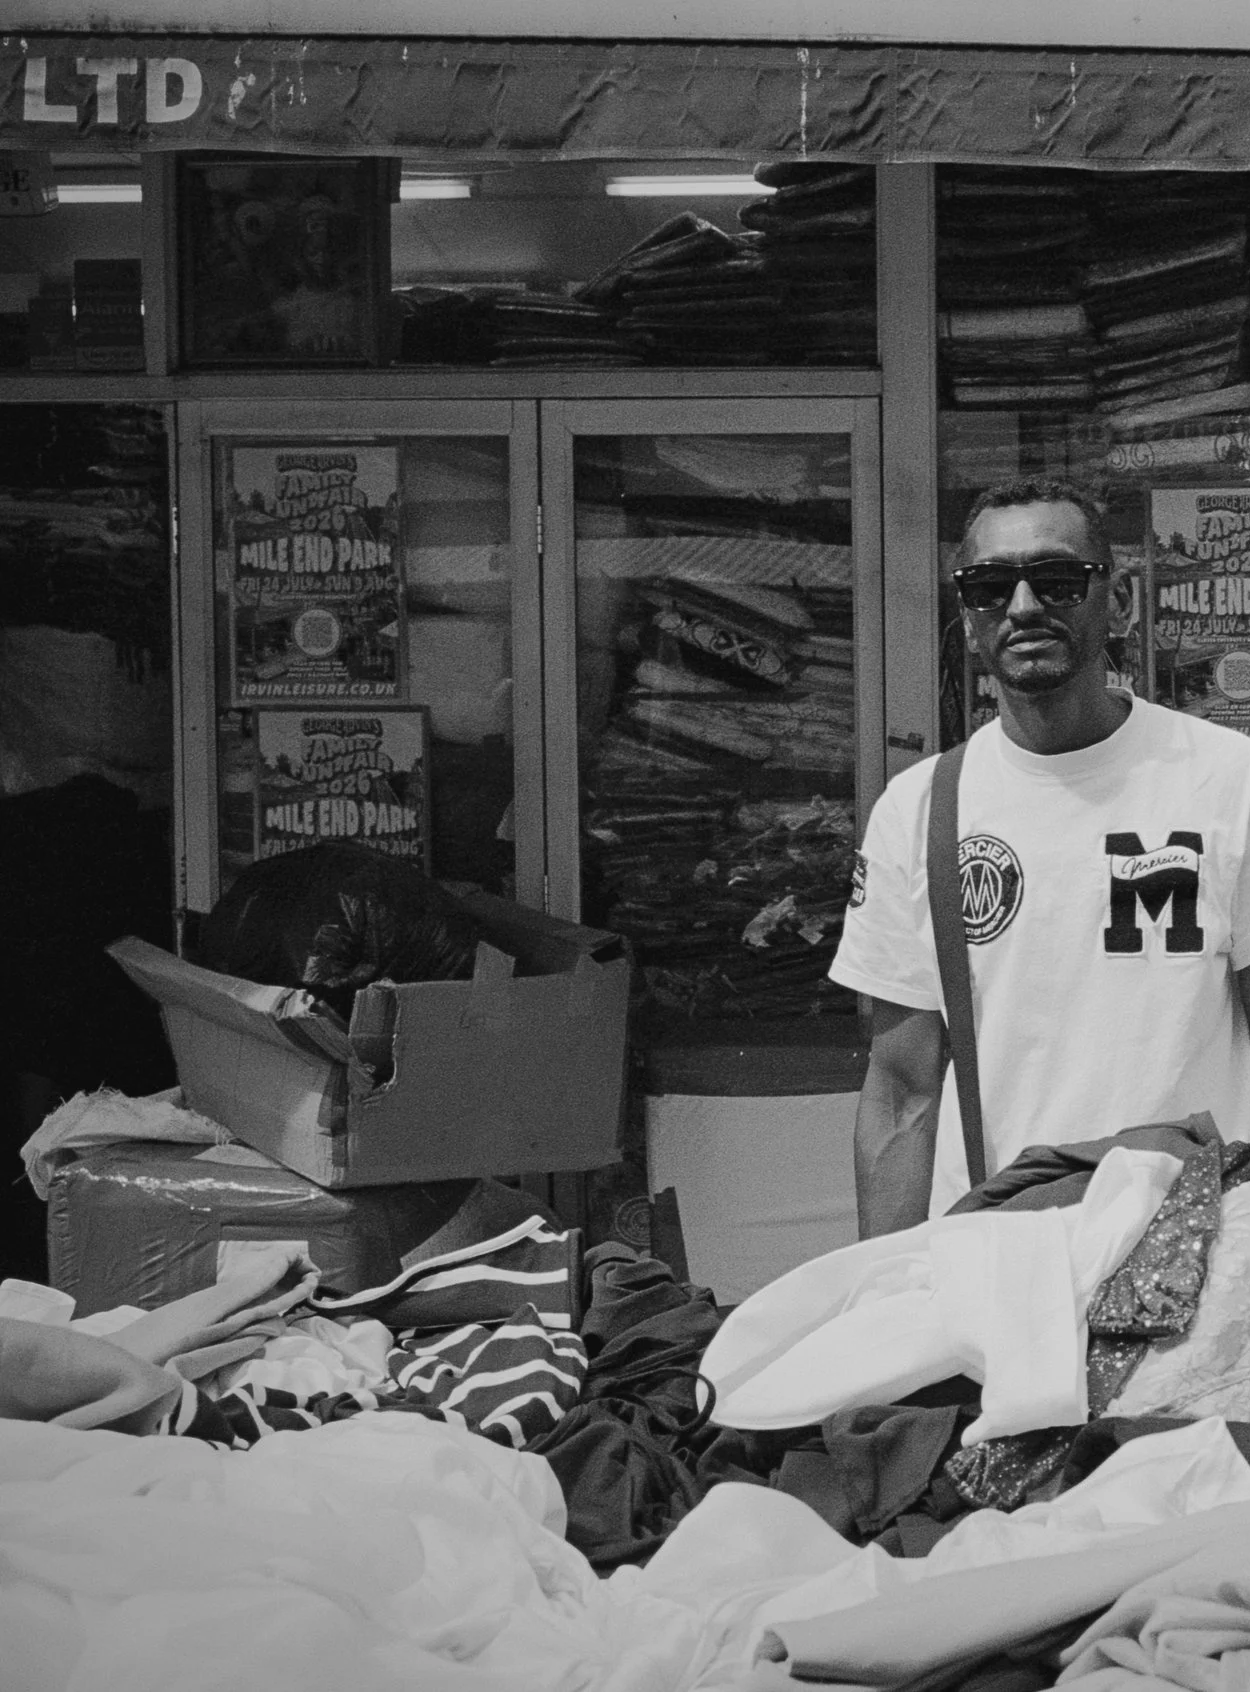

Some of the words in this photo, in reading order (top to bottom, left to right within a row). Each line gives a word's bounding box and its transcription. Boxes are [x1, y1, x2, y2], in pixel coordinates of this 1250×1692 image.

[22, 57, 204, 124] LTD
[276, 473, 357, 499] FAMILY
[1197, 494, 1239, 511] GEORGE
[288, 505, 346, 532] 2026
[240, 537, 289, 572] MILE
[293, 534, 334, 573] END
[338, 537, 392, 572] PARK
[236, 576, 260, 592] FRI
[263, 576, 280, 591] 24
[281, 576, 313, 593] JULY
[325, 576, 352, 592] SUN
[365, 575, 396, 592] AUG
[1159, 580, 1211, 615] MILE
[1157, 618, 1180, 637] FRI
[1182, 618, 1201, 635] 24
[1202, 617, 1236, 636] JULY
[241, 682, 398, 697] IRVINLEISURE.CO.UK
[301, 737, 382, 763] FAMILY
[315, 769, 372, 796] 2026
[265, 800, 315, 836] MILE
[318, 798, 359, 836] END
[363, 800, 417, 836] PARK
[957, 840, 1012, 871] ERCIER
[1104, 831, 1204, 953] M
